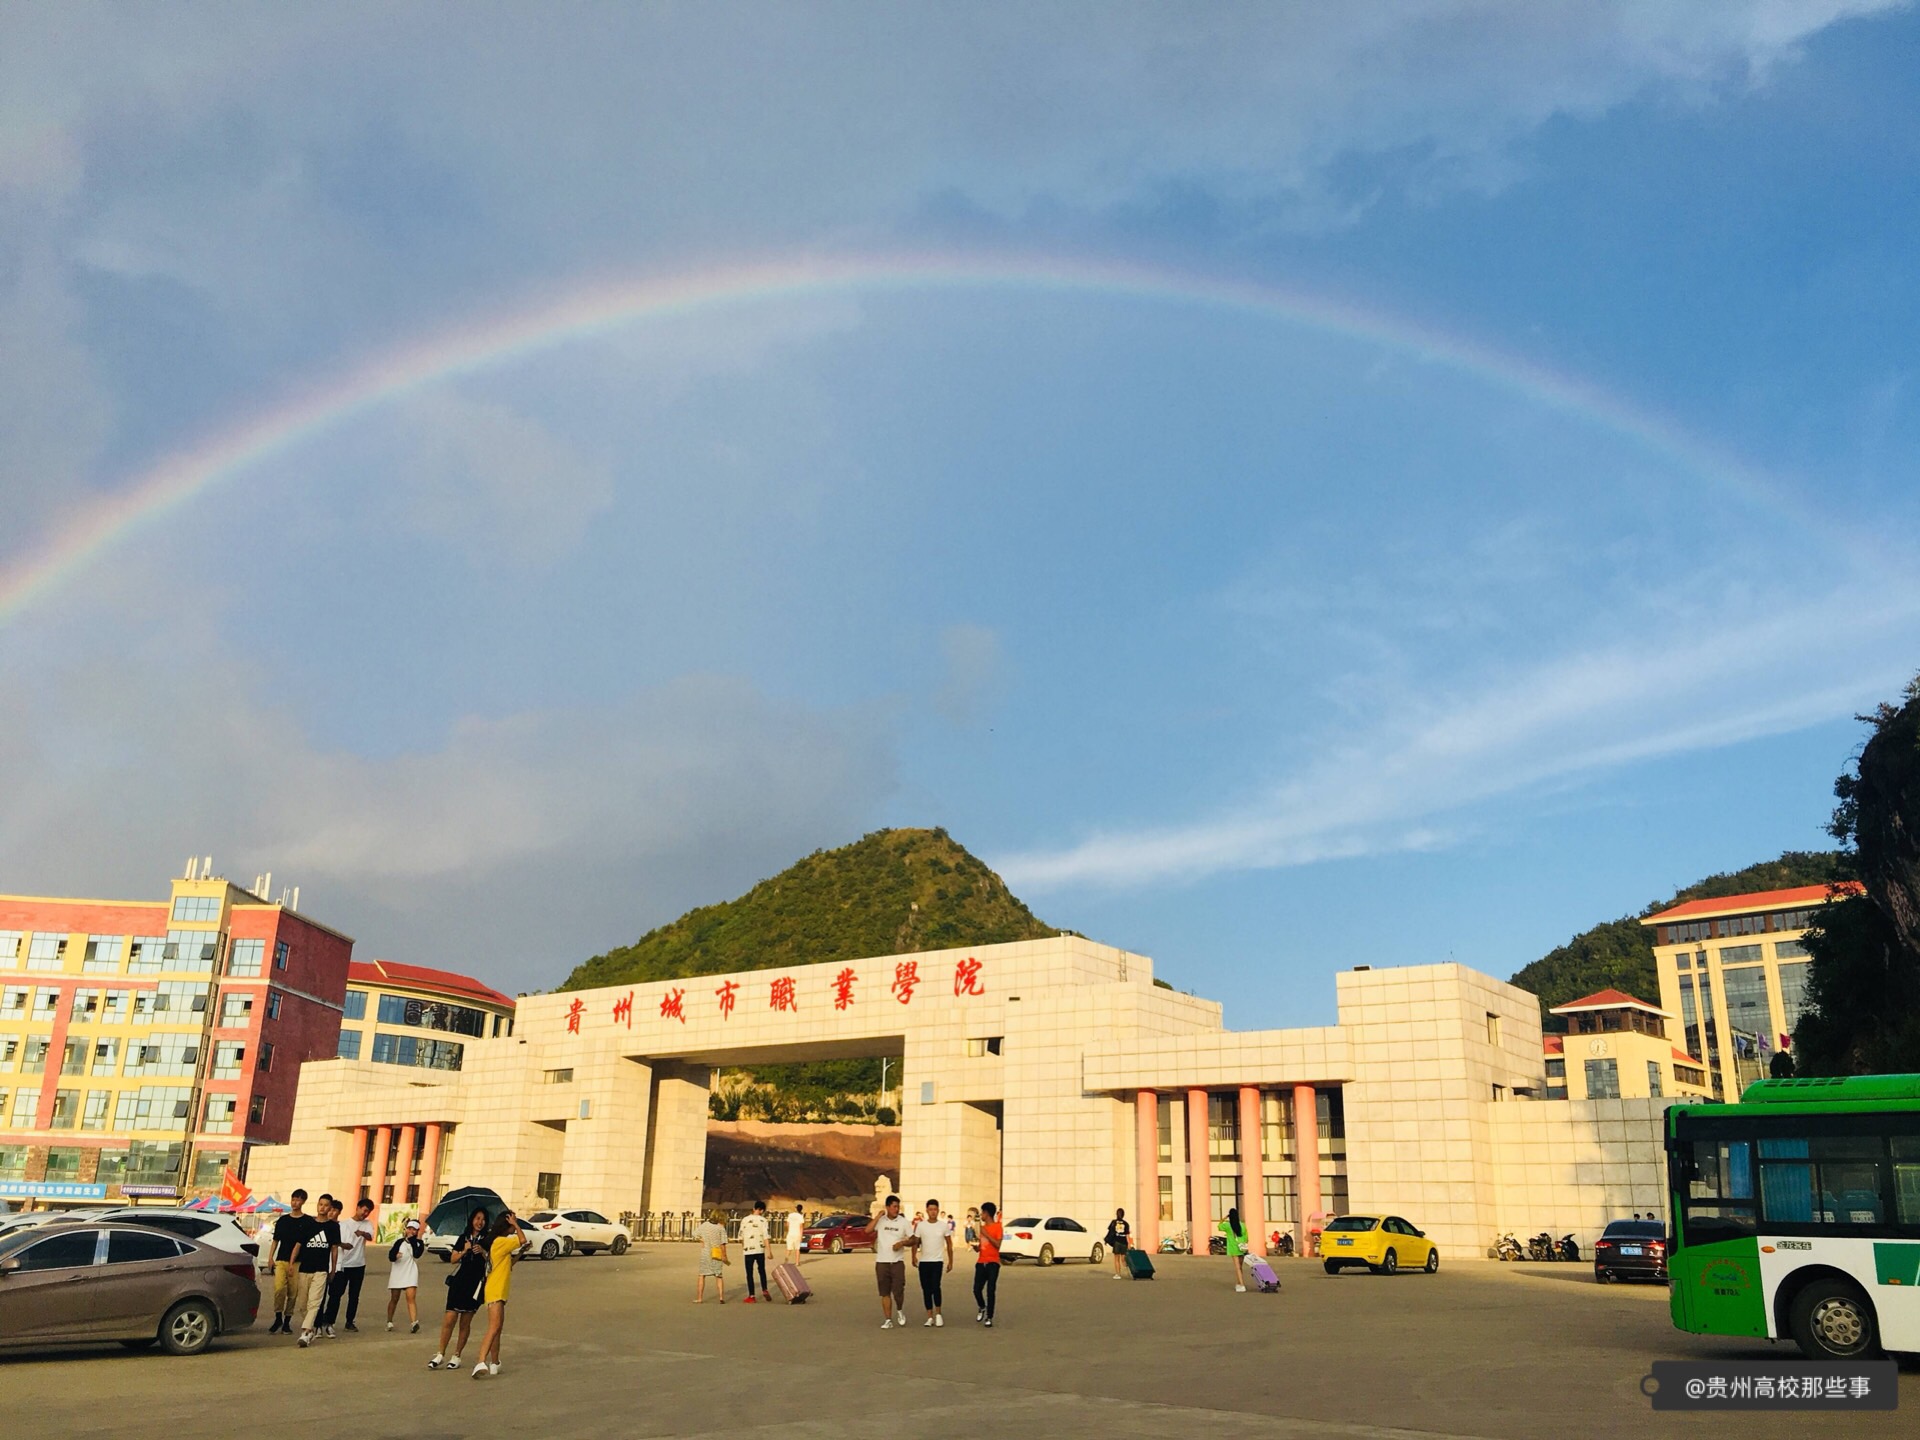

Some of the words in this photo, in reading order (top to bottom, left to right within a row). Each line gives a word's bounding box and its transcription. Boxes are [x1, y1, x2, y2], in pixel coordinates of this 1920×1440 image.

[564, 957, 985, 1035] 貴州城市職業學院
[306, 1240, 329, 1248] adidas
